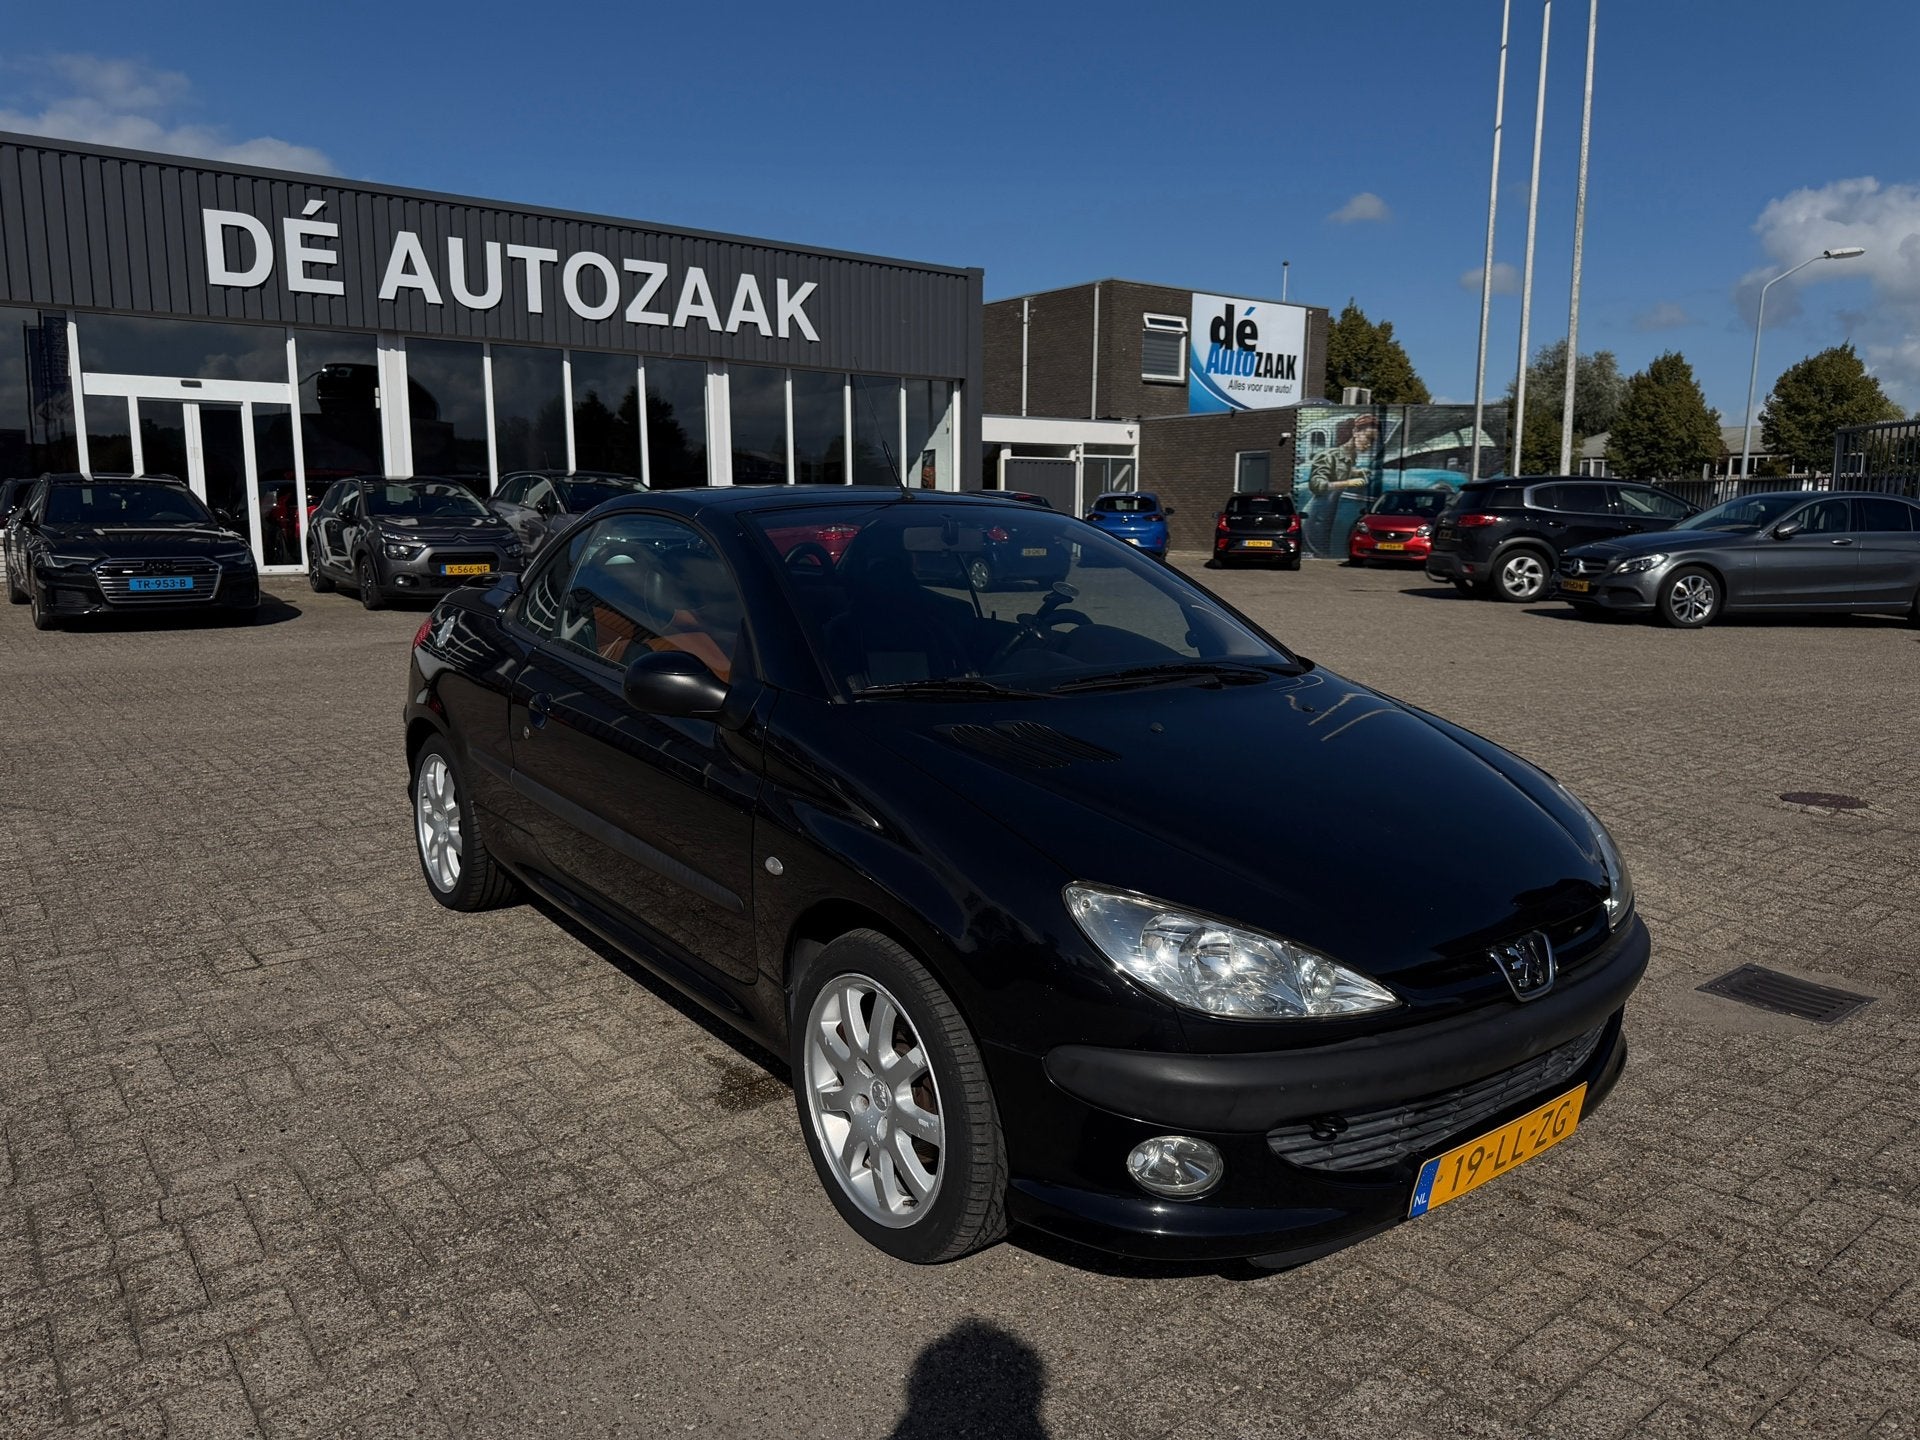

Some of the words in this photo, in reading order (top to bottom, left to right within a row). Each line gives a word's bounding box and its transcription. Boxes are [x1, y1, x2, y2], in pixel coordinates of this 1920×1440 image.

[203, 200, 344, 296] DÉ
[378, 231, 820, 342] AUTOZAAK
[1210, 303, 1258, 352] dé
[1228, 379, 1245, 390] Alles
[1247, 383, 1262, 392] voor
[1263, 384, 1273, 392] uw
[1275, 385, 1292, 394] auto!
[136, 579, 187, 589] TR-953-B
[1413, 1192, 1427, 1207] NL
[1451, 1100, 1571, 1192] 19-LL-ZG
